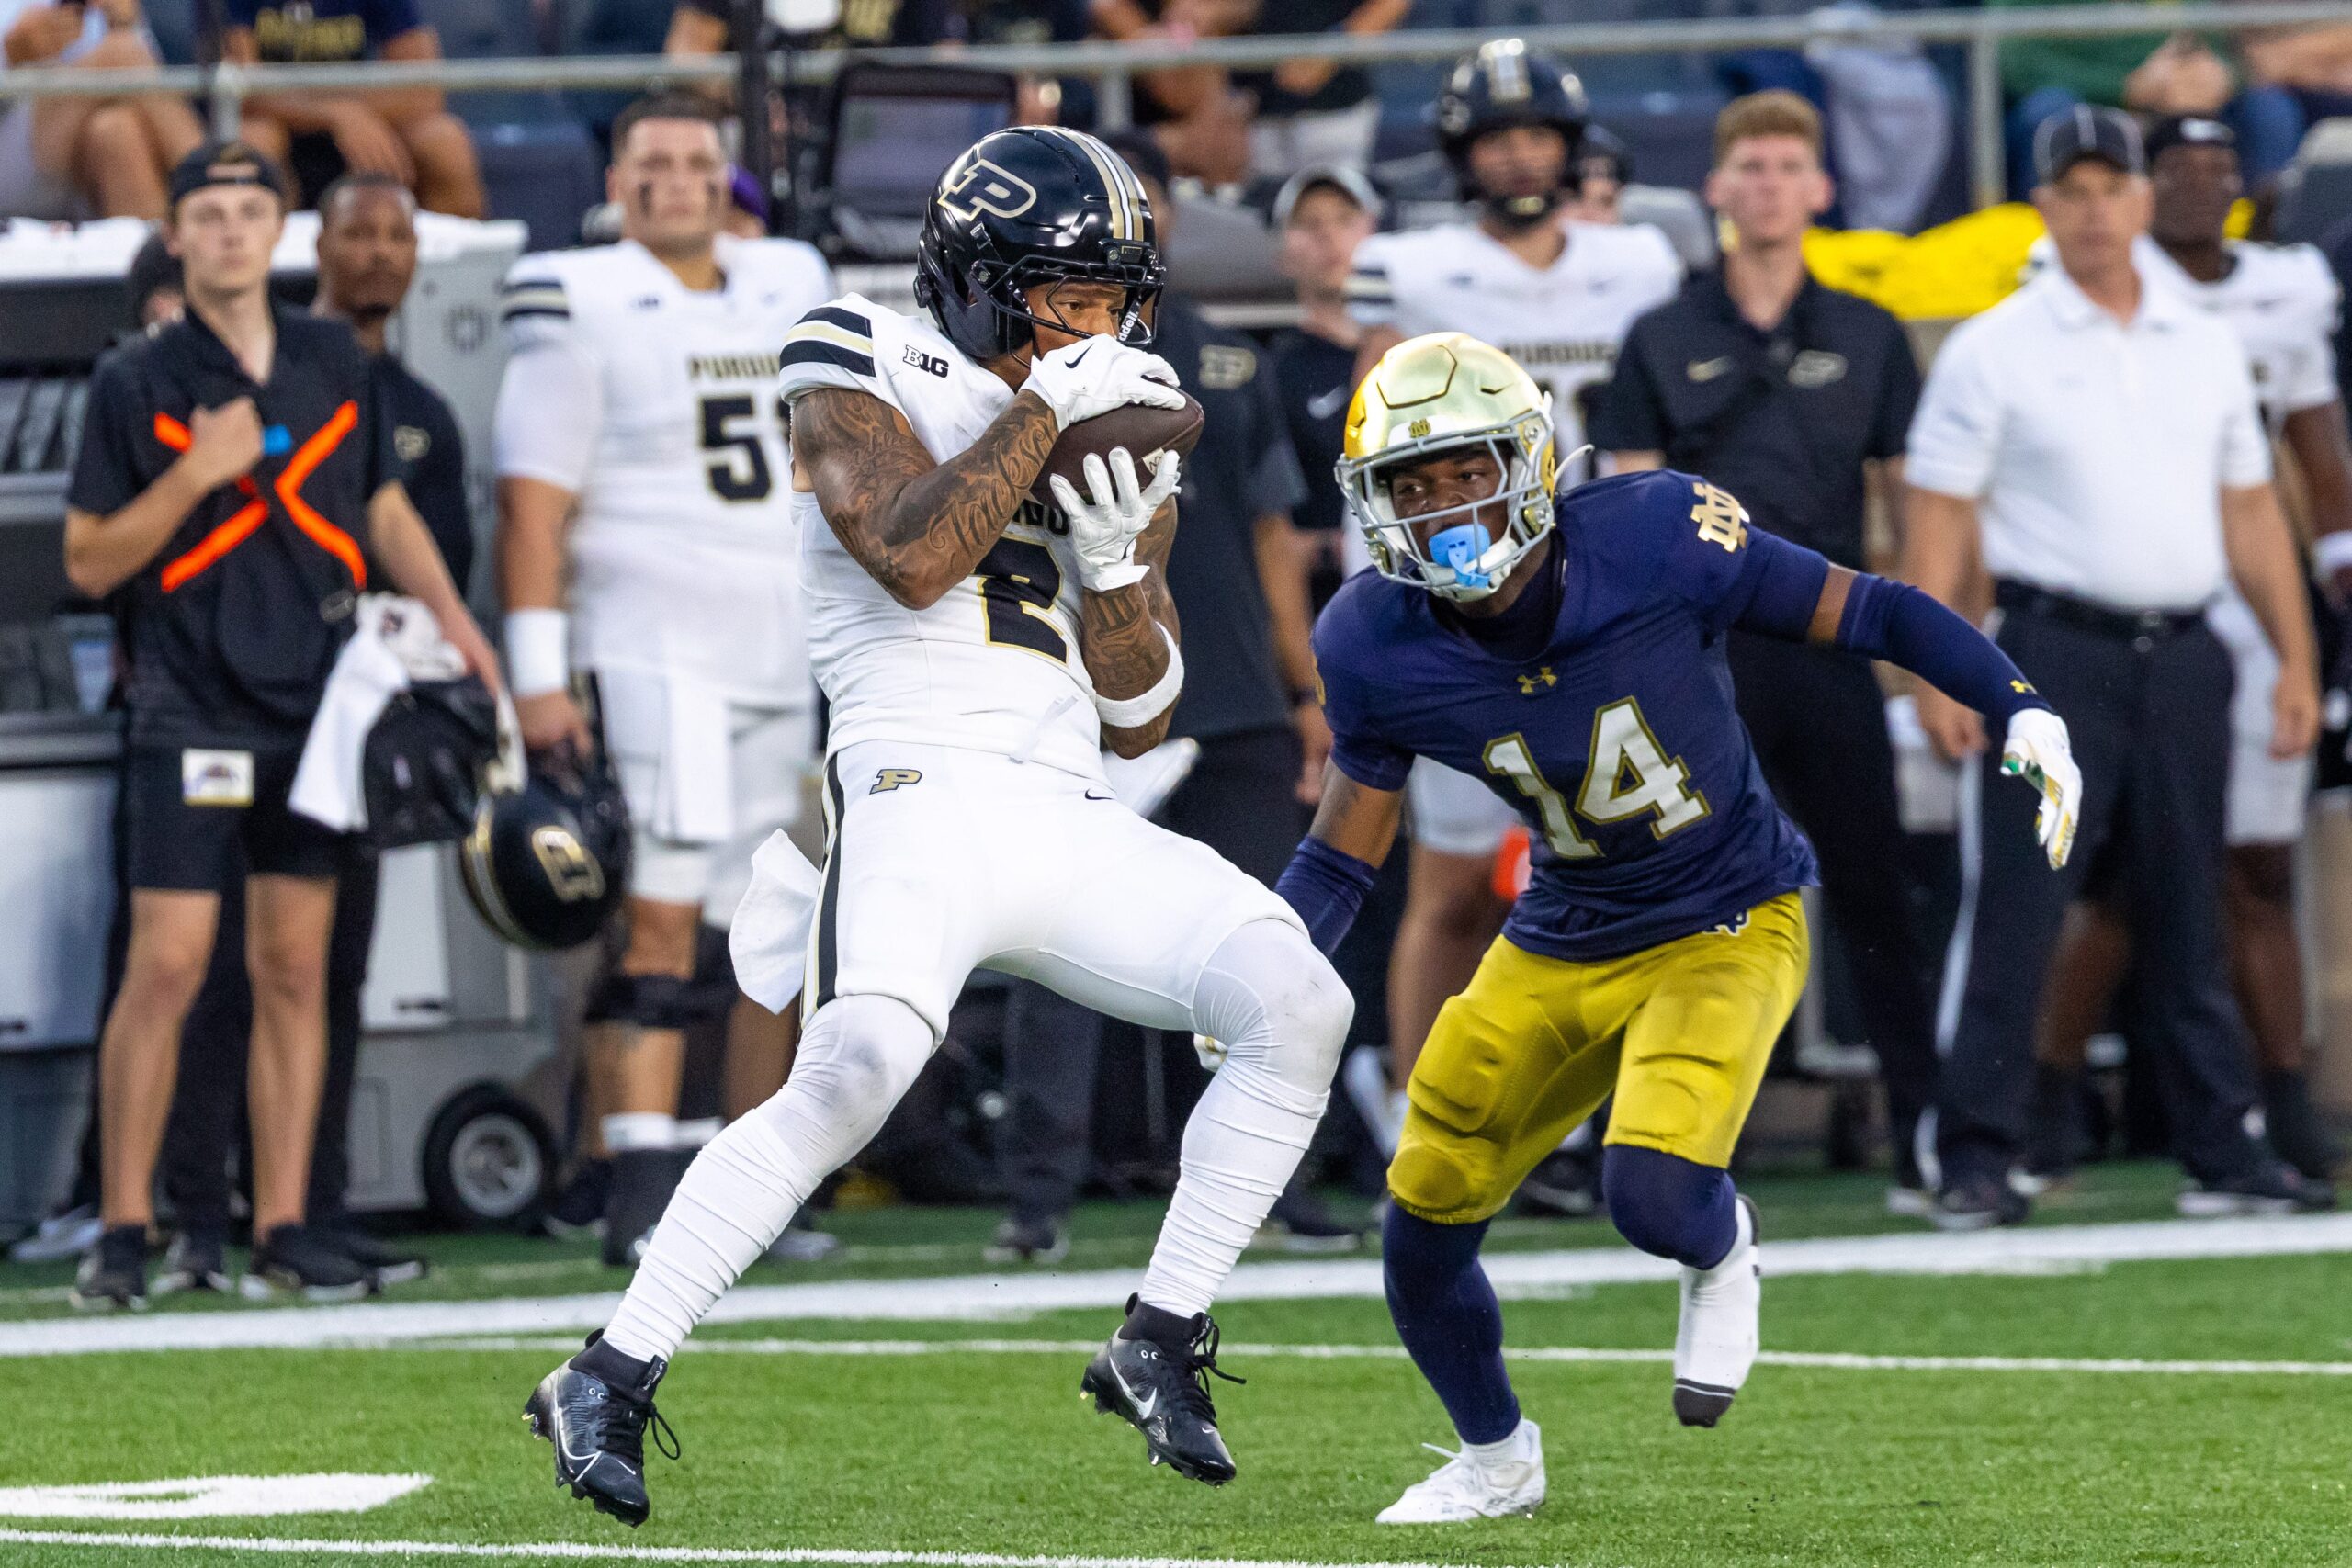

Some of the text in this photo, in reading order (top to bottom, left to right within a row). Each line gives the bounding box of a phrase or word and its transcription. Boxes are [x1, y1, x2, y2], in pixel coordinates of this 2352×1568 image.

[937, 158, 1037, 221] P
[1118, 310, 1139, 342] ddell
[689, 355, 781, 379] PURDU
[697, 393, 791, 503] 5
[974, 535, 1069, 666] 2
[869, 768, 922, 795] P
[1482, 695, 1712, 859] 14
